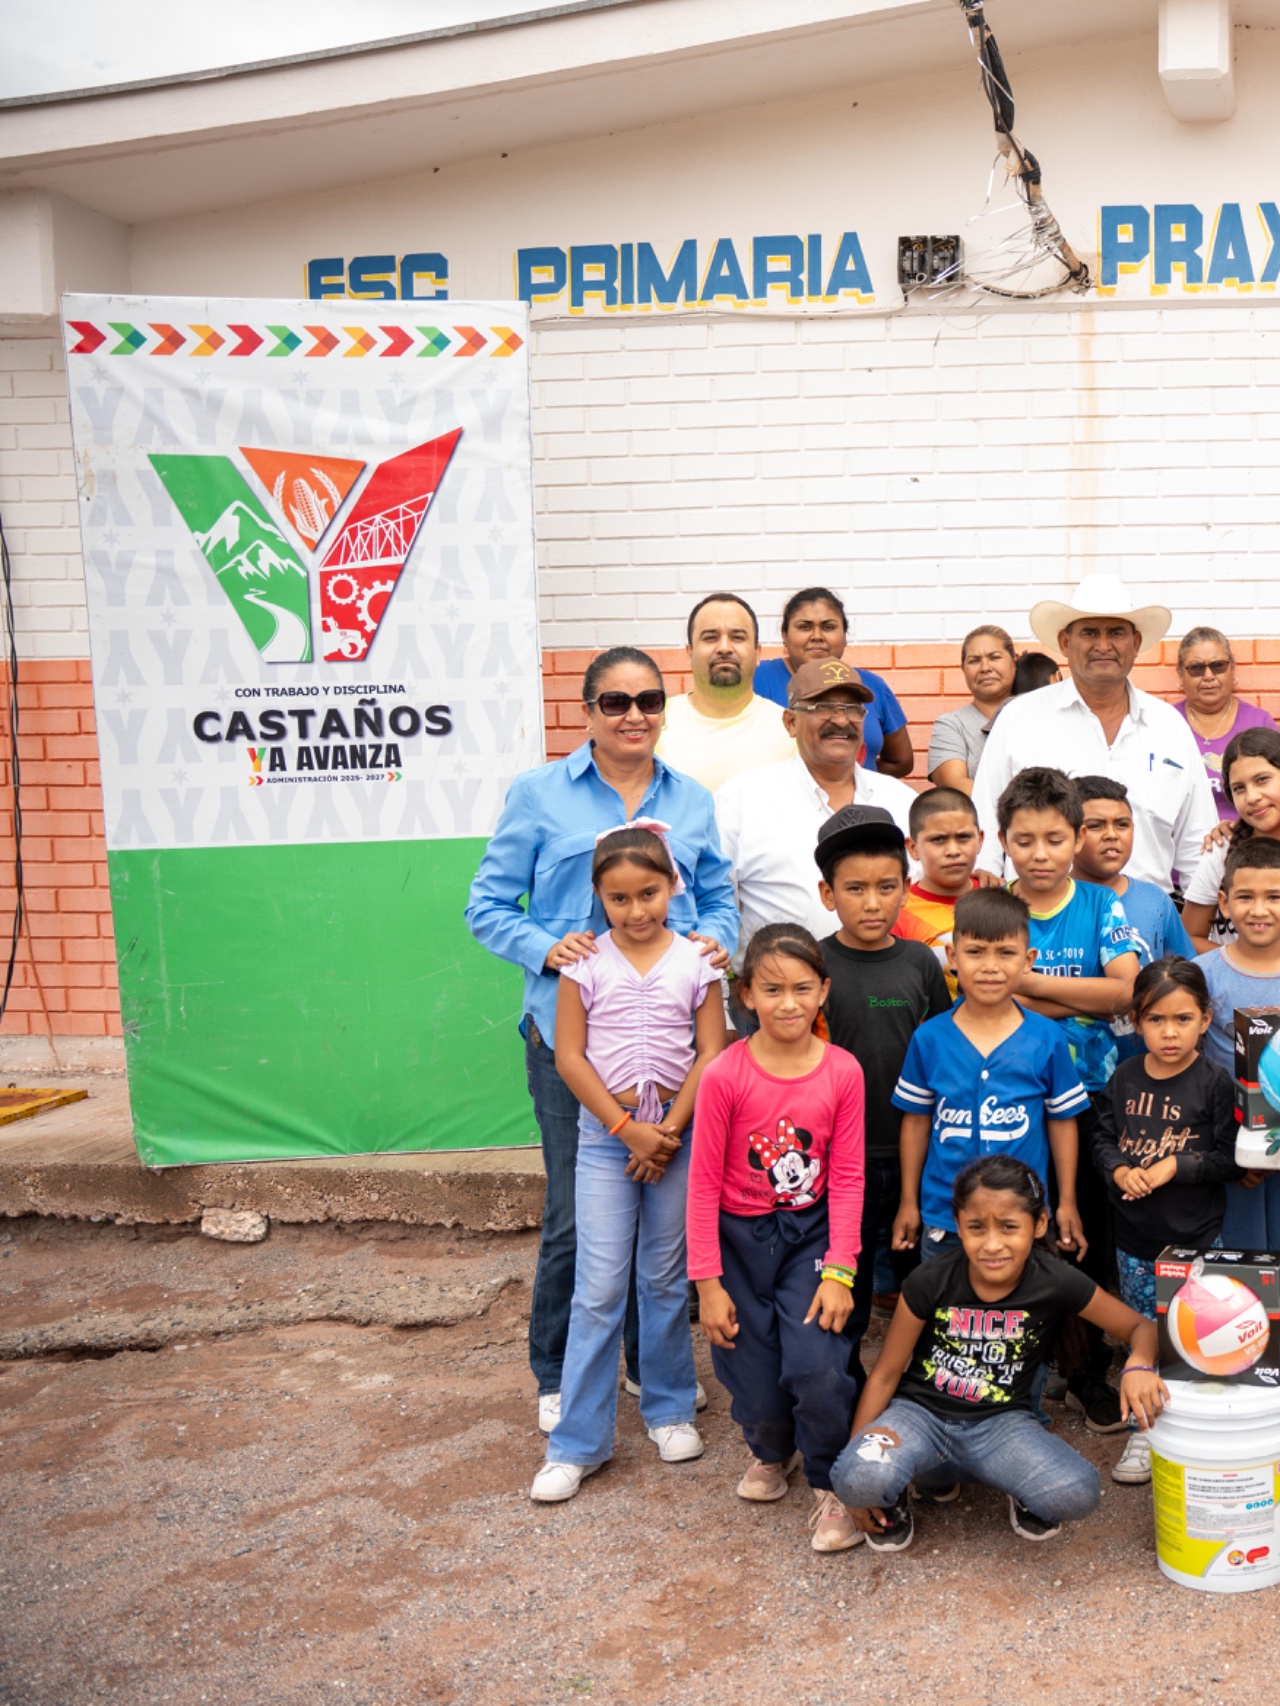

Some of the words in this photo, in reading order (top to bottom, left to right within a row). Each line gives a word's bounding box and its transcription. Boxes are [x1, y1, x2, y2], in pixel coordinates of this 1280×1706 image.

[514, 232, 876, 315] PRIMARIA
[234, 687, 261, 698] CON
[264, 686, 319, 697] TRABAJO
[322, 686, 331, 695] Y
[333, 684, 405, 696] DISCIPLINA
[193, 698, 453, 743] CASTAÑOS
[247, 746, 287, 772] YA
[296, 743, 402, 771] AVANZA
[266, 774, 338, 784] ADMINISTRACIÓN
[867, 995, 912, 1009] Boston
[1248, 1026, 1273, 1035] Voit
[1125, 1091, 1155, 1117] all
[1161, 1096, 1182, 1121] is
[947, 1307, 1025, 1340] NICE
[1237, 1321, 1263, 1343] Voit
[958, 1341, 1007, 1364] TO
